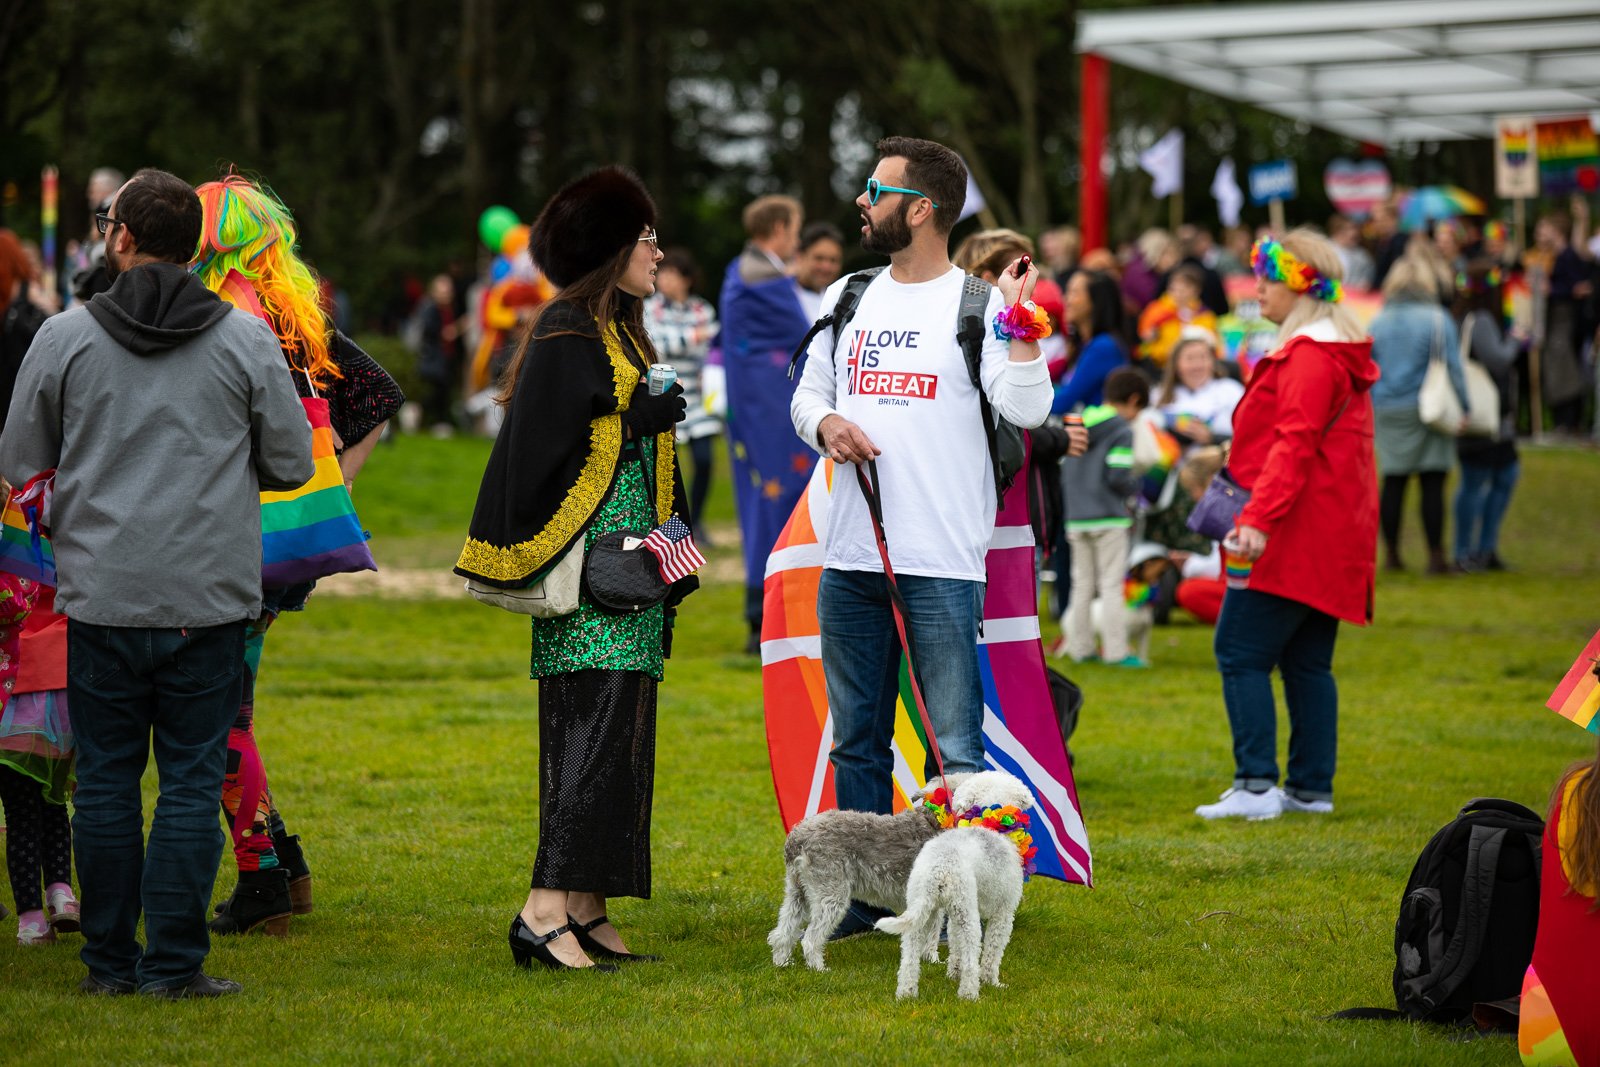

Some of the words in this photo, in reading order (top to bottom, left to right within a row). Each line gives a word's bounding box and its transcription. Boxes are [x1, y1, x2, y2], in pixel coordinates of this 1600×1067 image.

[865, 330, 920, 348] LOVE
[861, 350, 880, 368] IS
[861, 373, 935, 396] GREAT
[878, 398, 910, 407] BRITAIN
